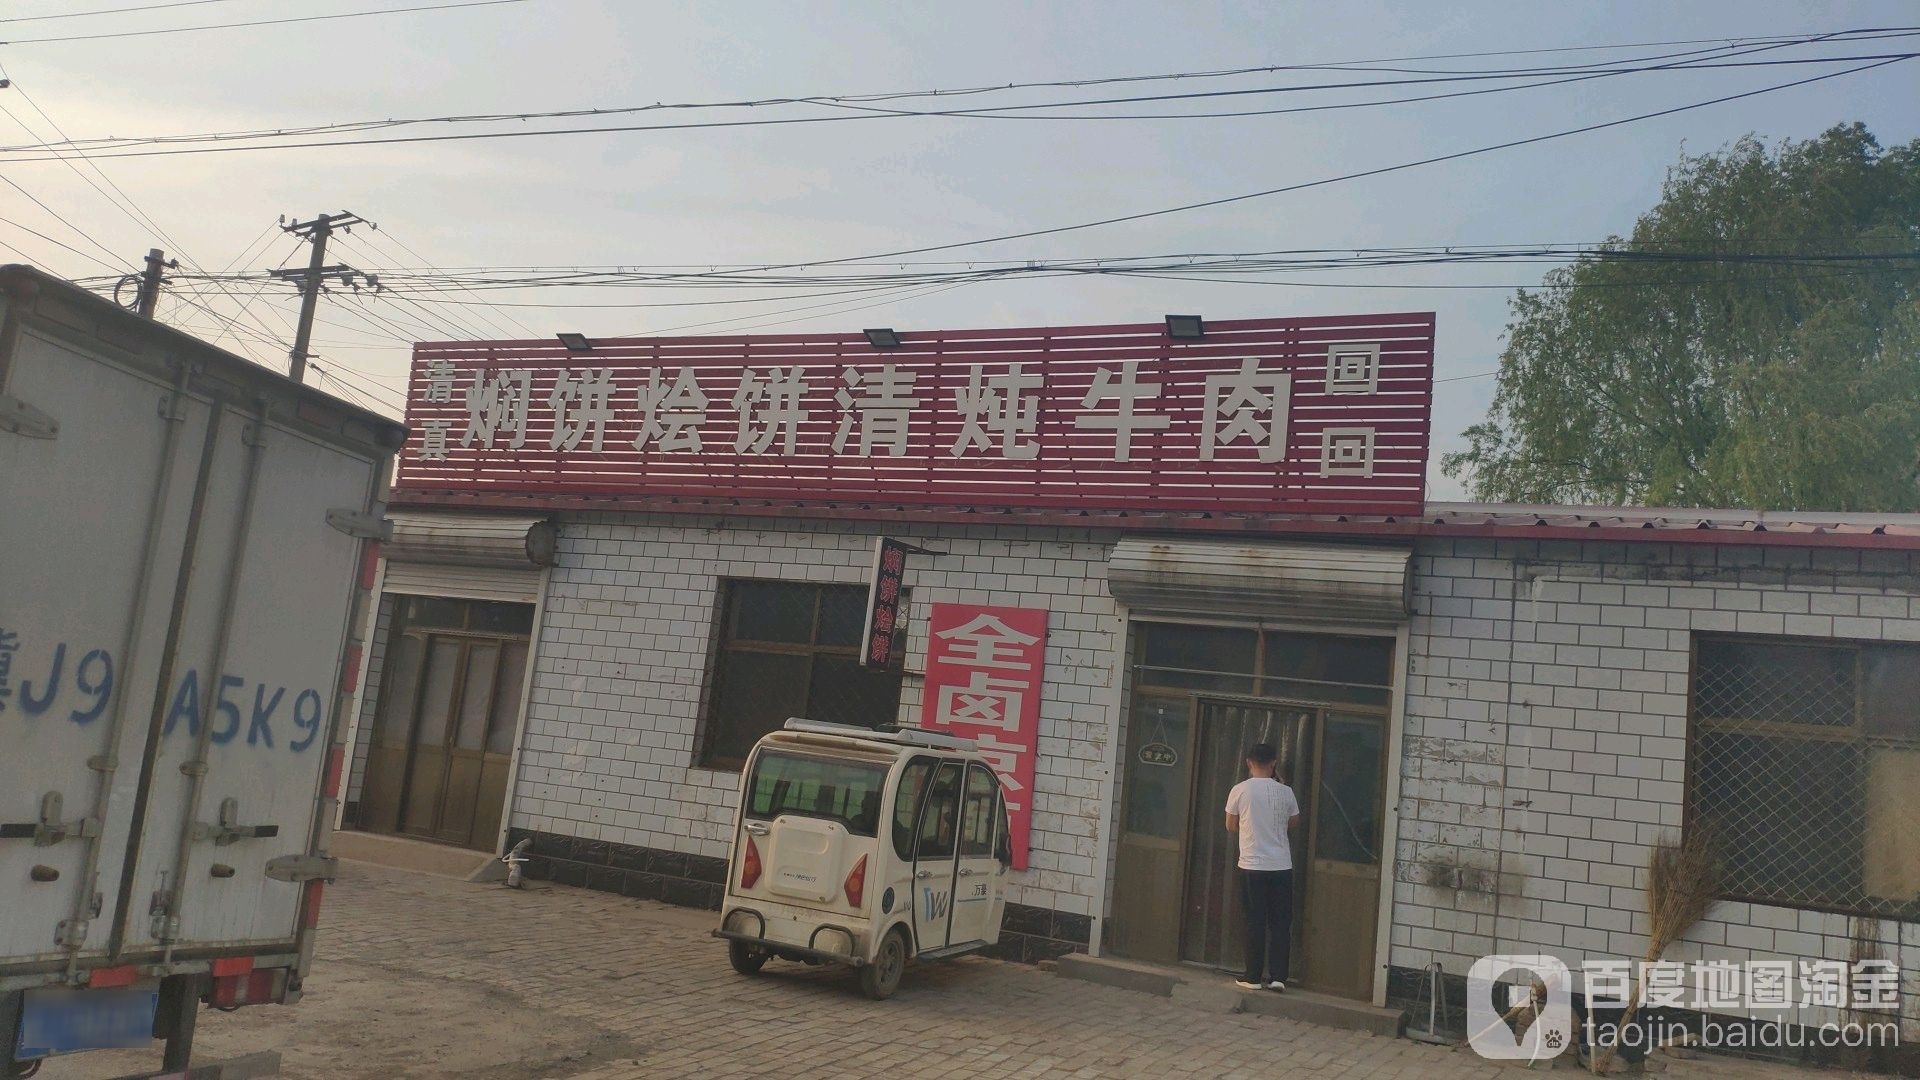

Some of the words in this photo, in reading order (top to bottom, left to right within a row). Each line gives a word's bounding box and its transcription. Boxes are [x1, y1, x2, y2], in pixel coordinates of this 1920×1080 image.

[417, 360, 456, 462] 清真
[459, 358, 1292, 464] 焖饼烩饼清炖牛肉
